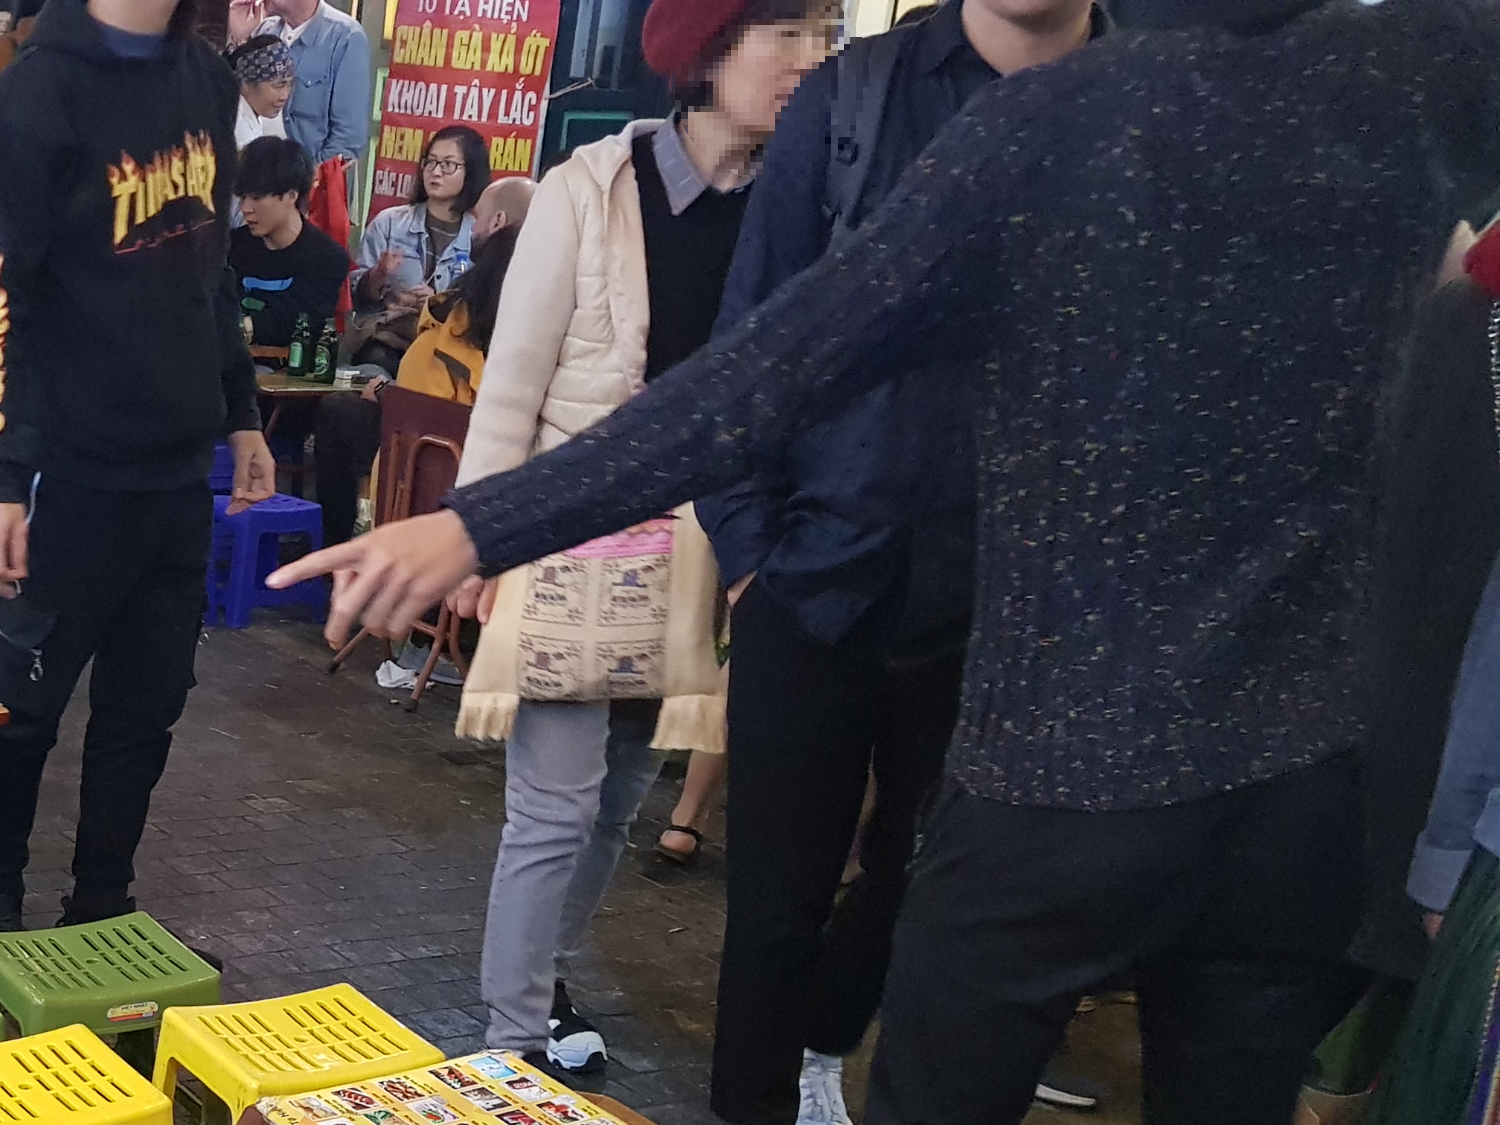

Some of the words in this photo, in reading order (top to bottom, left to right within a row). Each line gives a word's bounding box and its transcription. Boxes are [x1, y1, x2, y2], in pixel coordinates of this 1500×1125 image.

[393, 20, 449, 68] CHÂN
[451, 24, 483, 71] GÀ
[387, 78, 448, 119] KHOAI
[453, 79, 496, 123] TÂY
[496, 77, 538, 126] LẮC
[380, 125, 424, 163] NEM
[489, 132, 532, 172] RÁN
[374, 167, 395, 197] CÁC
